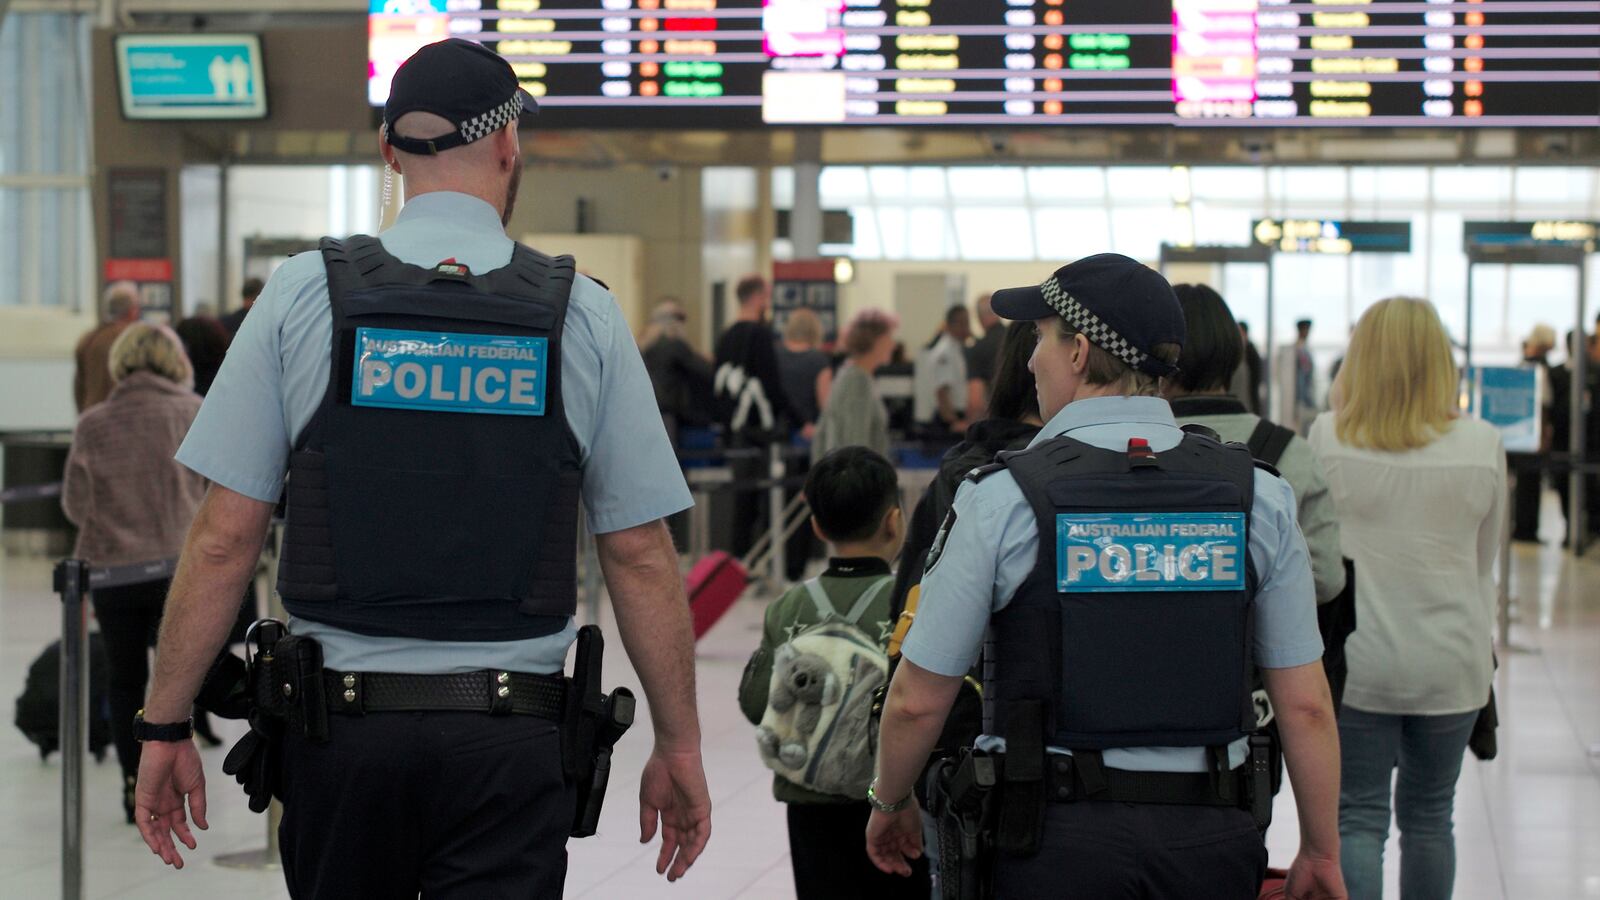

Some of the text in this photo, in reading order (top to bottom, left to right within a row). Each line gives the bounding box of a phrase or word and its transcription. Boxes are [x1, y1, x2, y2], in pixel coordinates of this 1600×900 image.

[365, 338, 537, 361] AUSTRALIAN FEDERAL
[361, 360, 537, 405] POLICE
[1067, 523, 1237, 537] AUSTRALIAN FEDERAL
[1067, 544, 1237, 581] POLICE
